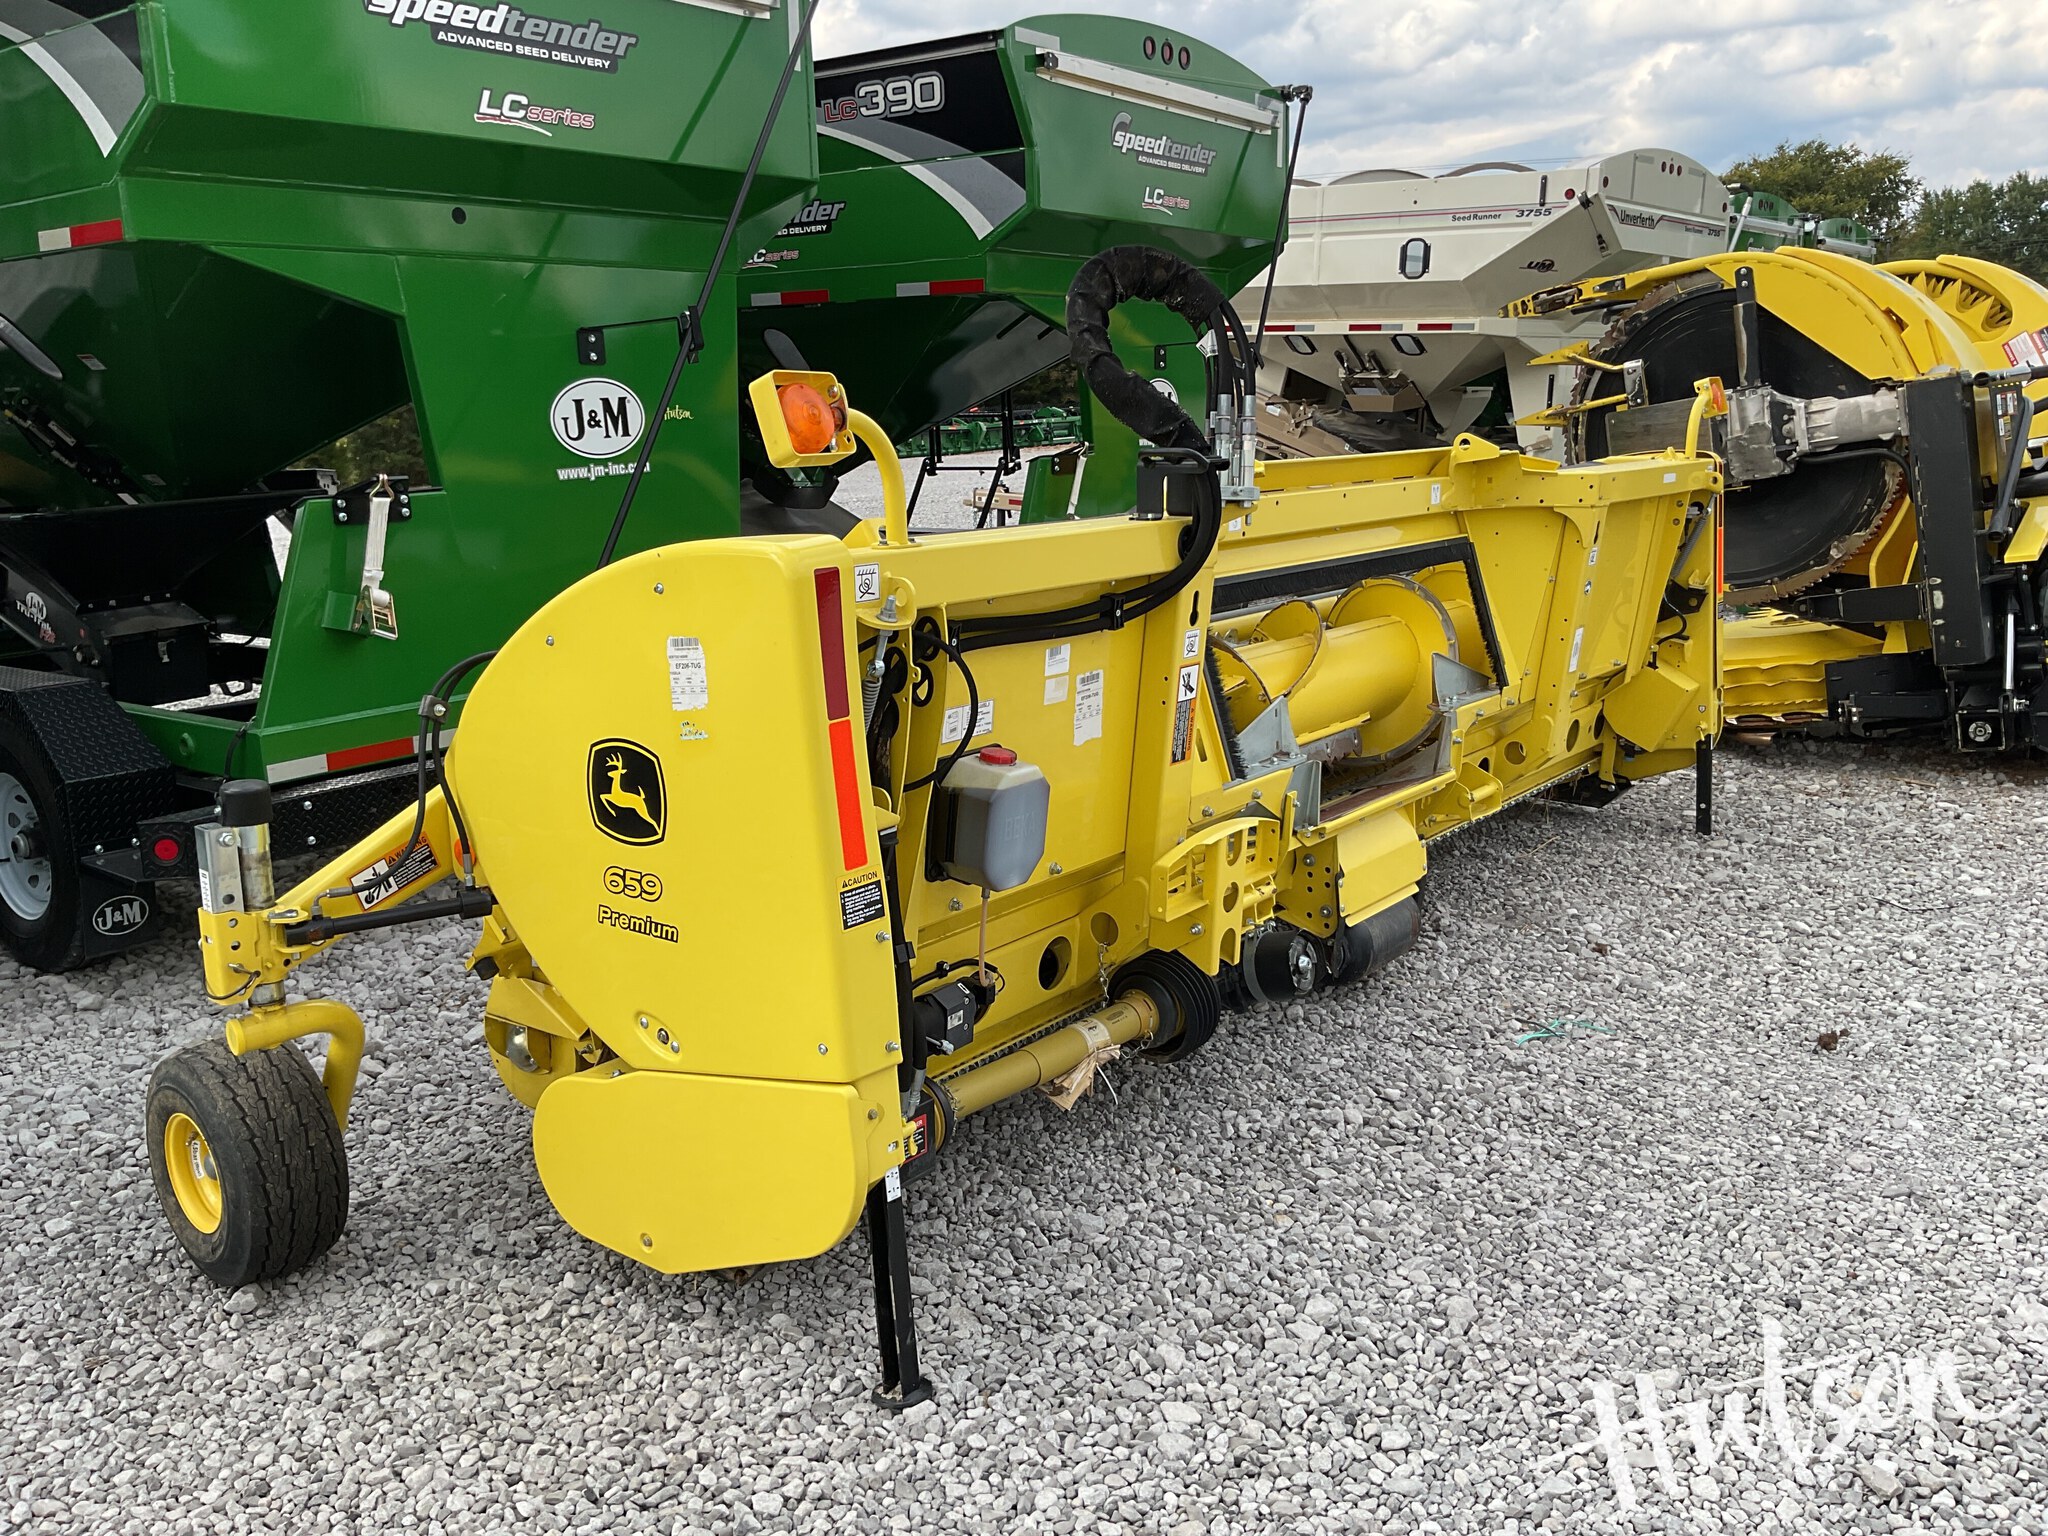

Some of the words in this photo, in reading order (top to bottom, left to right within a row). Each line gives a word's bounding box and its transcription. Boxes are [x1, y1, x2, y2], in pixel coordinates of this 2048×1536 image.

[437, 31, 513, 53] ADVANCED
[516, 44, 549, 59] SEED
[551, 50, 611, 69] DELIVERY
[824, 74, 943, 122] LC390
[1113, 131, 1217, 165] speedtender
[1138, 156, 1167, 167] ADVANCED
[1168, 161, 1181, 169] SEED
[1182, 163, 1205, 174] DELIVERY
[789, 225, 827, 235] DELIVERY
[1451, 214, 1471, 222] Seed
[1472, 213, 1502, 221] Runner
[1515, 208, 1552, 218] 3755
[1620, 210, 1655, 228] Unverferth
[561, 397, 631, 441] J&M
[603, 865, 663, 902] 659
[848, 871, 878, 887] CAUTION
[97, 901, 142, 930] J&M
[598, 904, 679, 943] Premium
